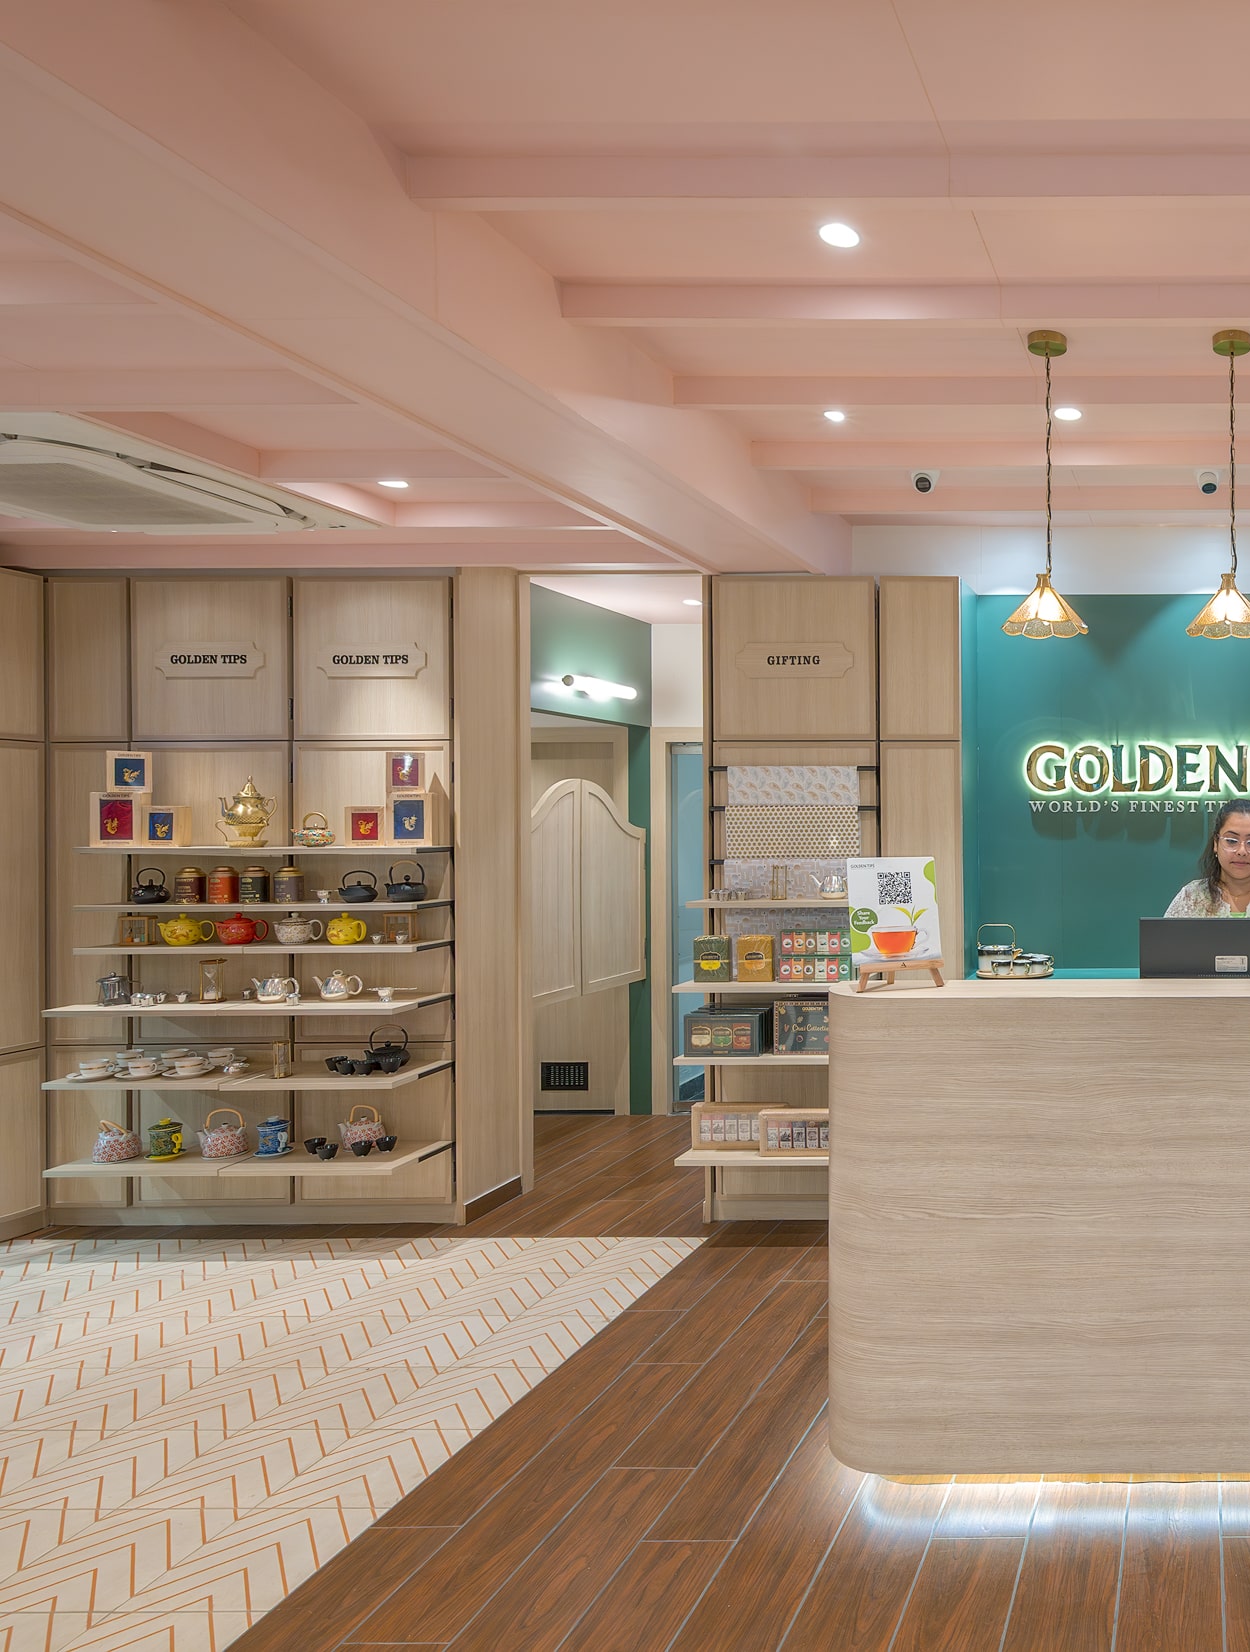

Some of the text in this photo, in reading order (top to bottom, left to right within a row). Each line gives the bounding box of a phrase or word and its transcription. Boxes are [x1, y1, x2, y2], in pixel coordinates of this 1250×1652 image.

[170, 654, 247, 665] GOLDEN TIPS
[332, 654, 409, 665] GOLDEN TIPS
[767, 655, 821, 666] GIFTING
[1025, 743, 1250, 793] GOLDEN
[1029, 800, 1120, 813] WORLD'S
[1129, 800, 1199, 813] FINEST
